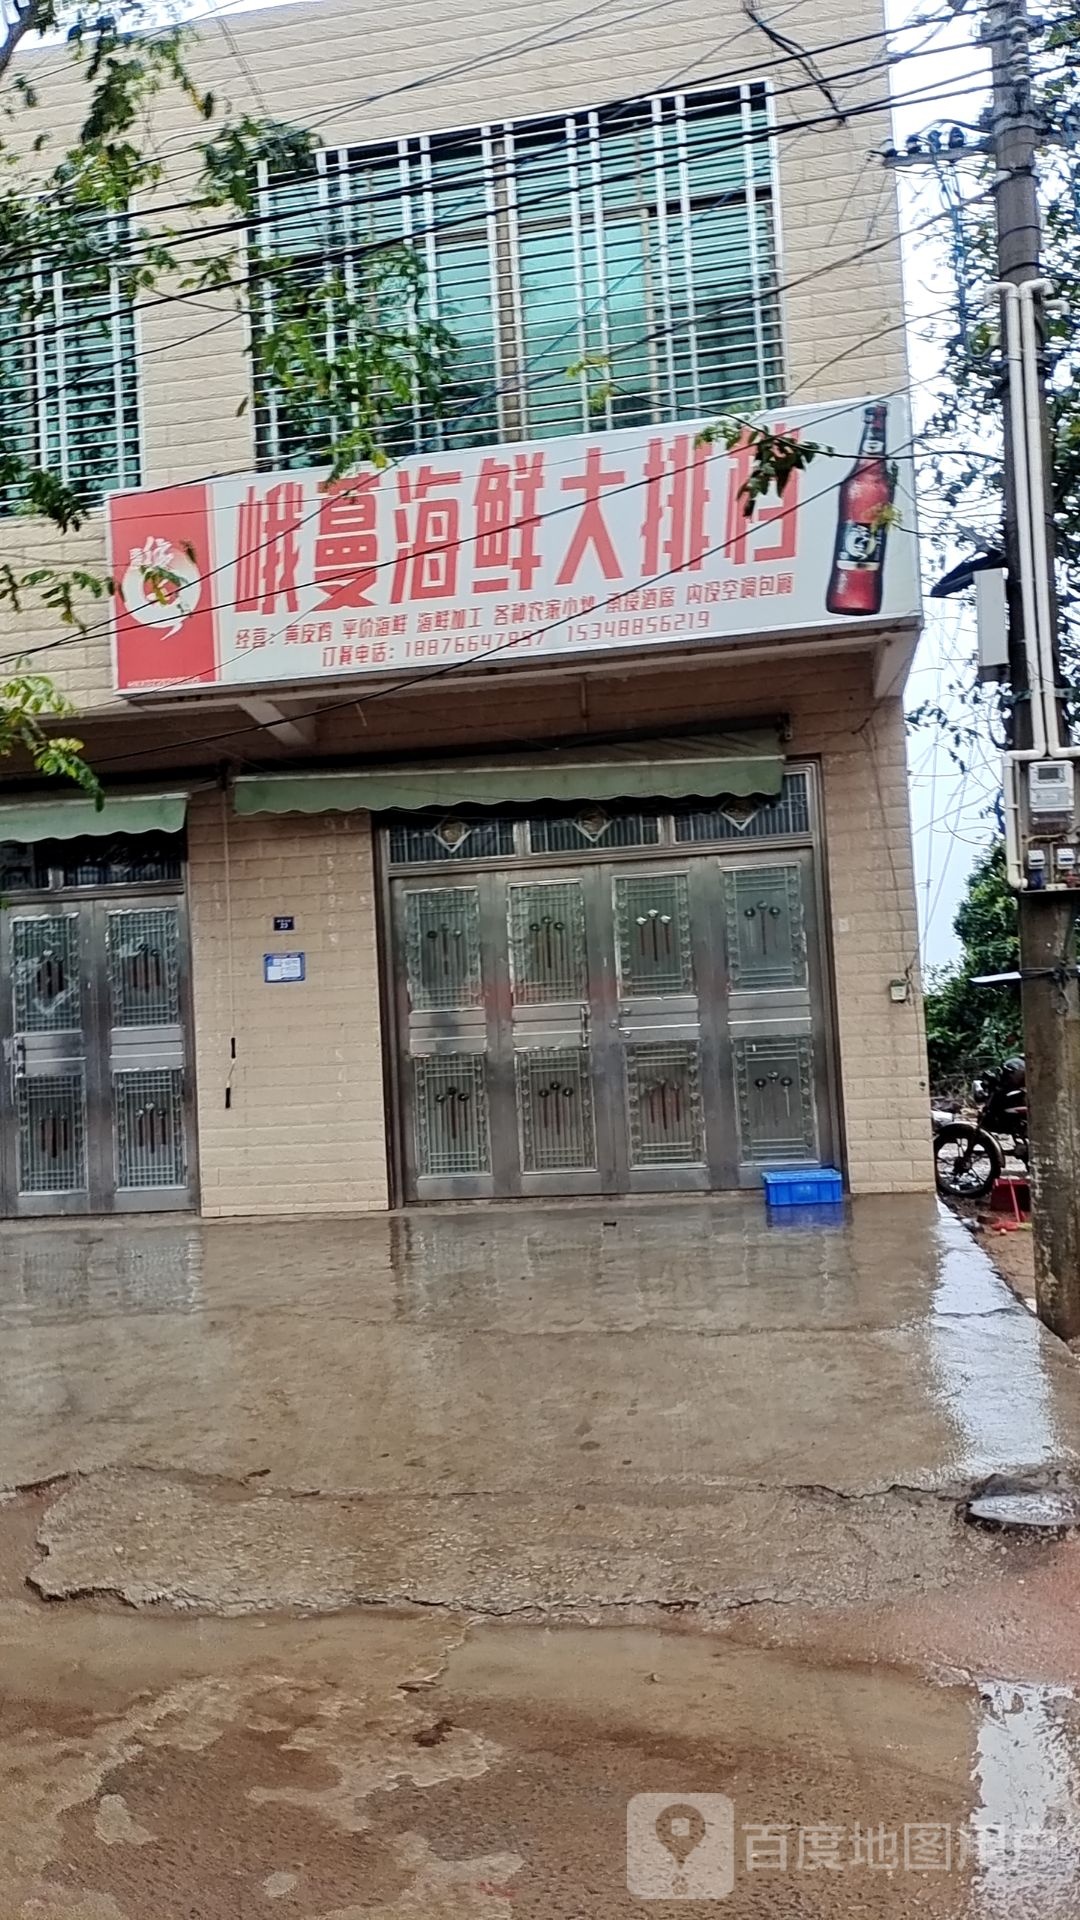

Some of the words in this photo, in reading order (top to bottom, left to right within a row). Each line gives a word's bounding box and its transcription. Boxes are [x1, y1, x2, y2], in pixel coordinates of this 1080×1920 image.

[234, 423, 801, 615] 峨蔓海鲜大排档
[416, 607, 483, 633] 海鲜加工
[567, 611, 710, 642] 15348856219
